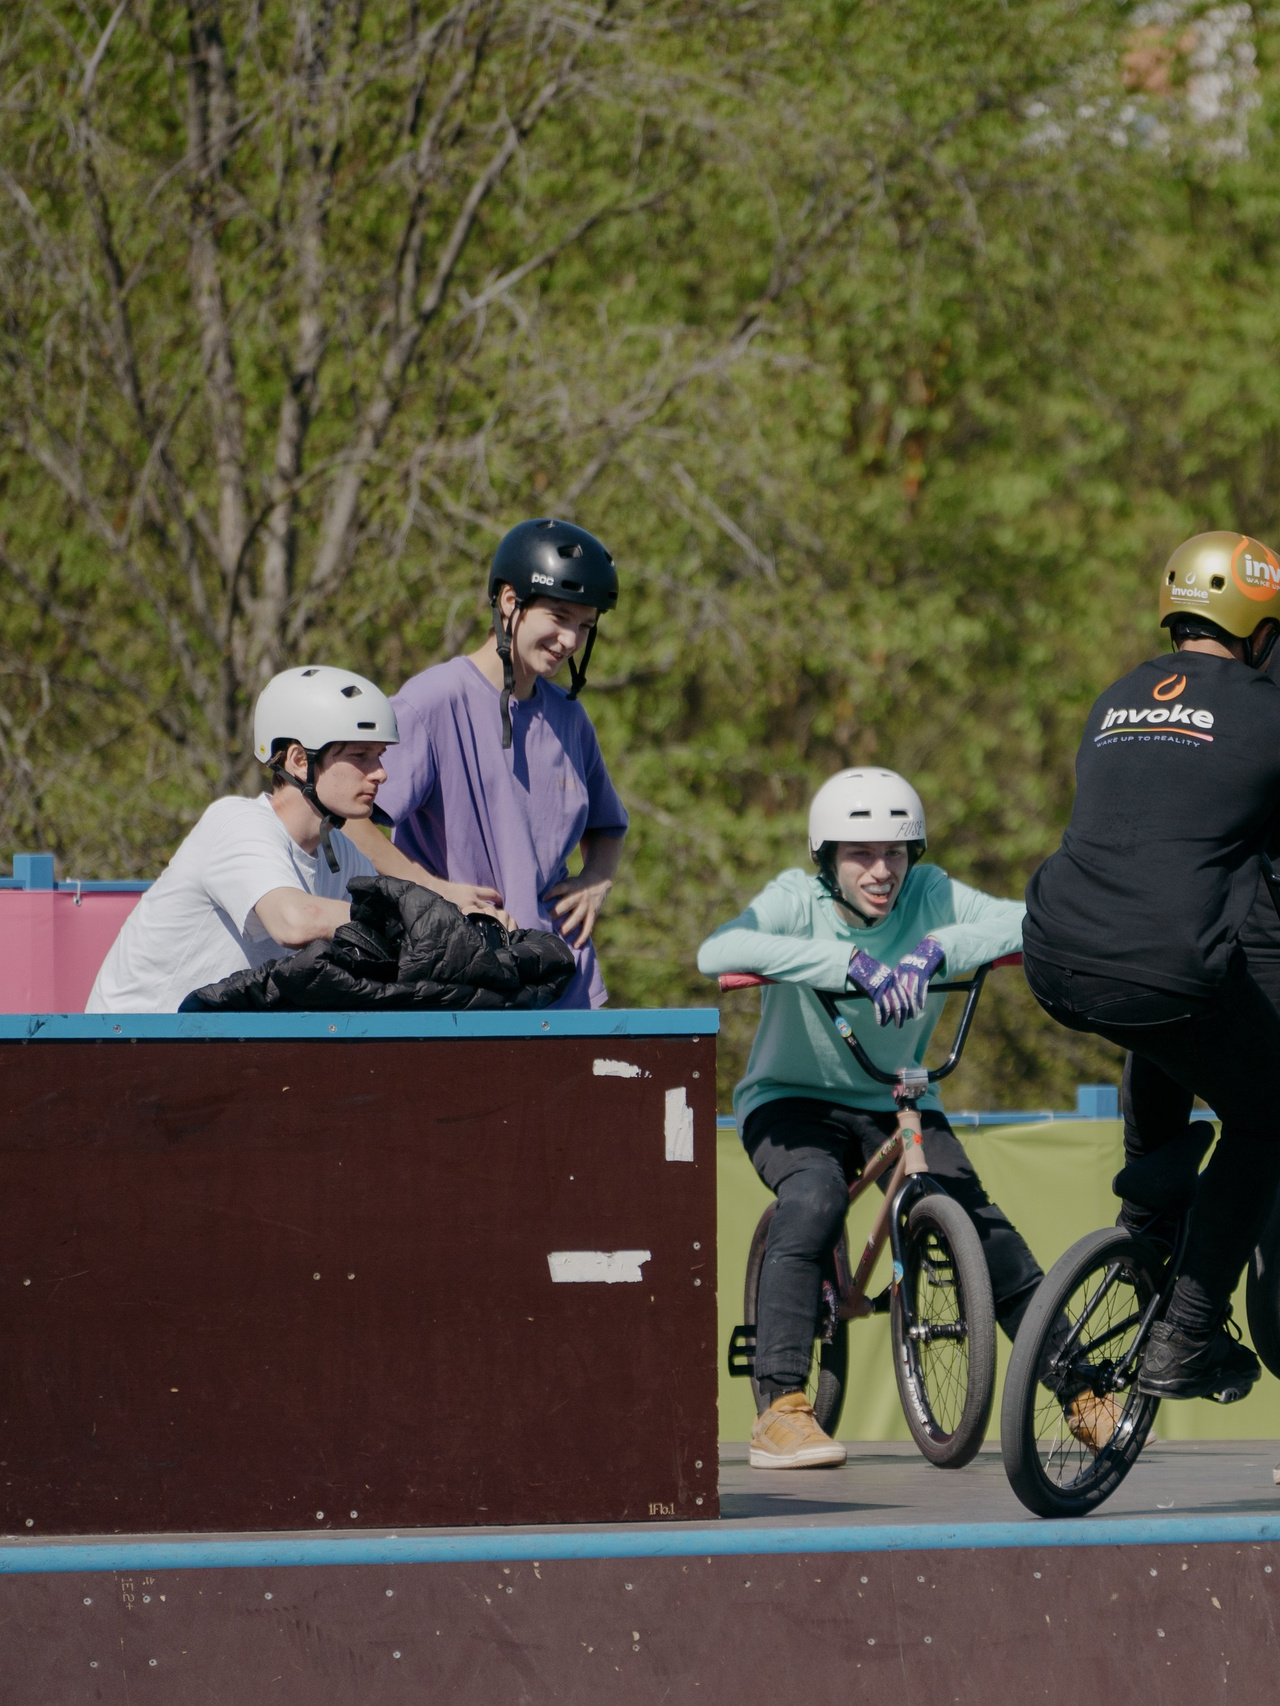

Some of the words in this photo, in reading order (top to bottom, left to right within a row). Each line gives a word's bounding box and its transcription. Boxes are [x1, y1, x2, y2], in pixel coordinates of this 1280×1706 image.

[1172, 585, 1209, 599] invoke
[1101, 704, 1215, 730] invoke
[1096, 737, 1118, 748] WAKE
[1153, 735, 1201, 748] REALITY
